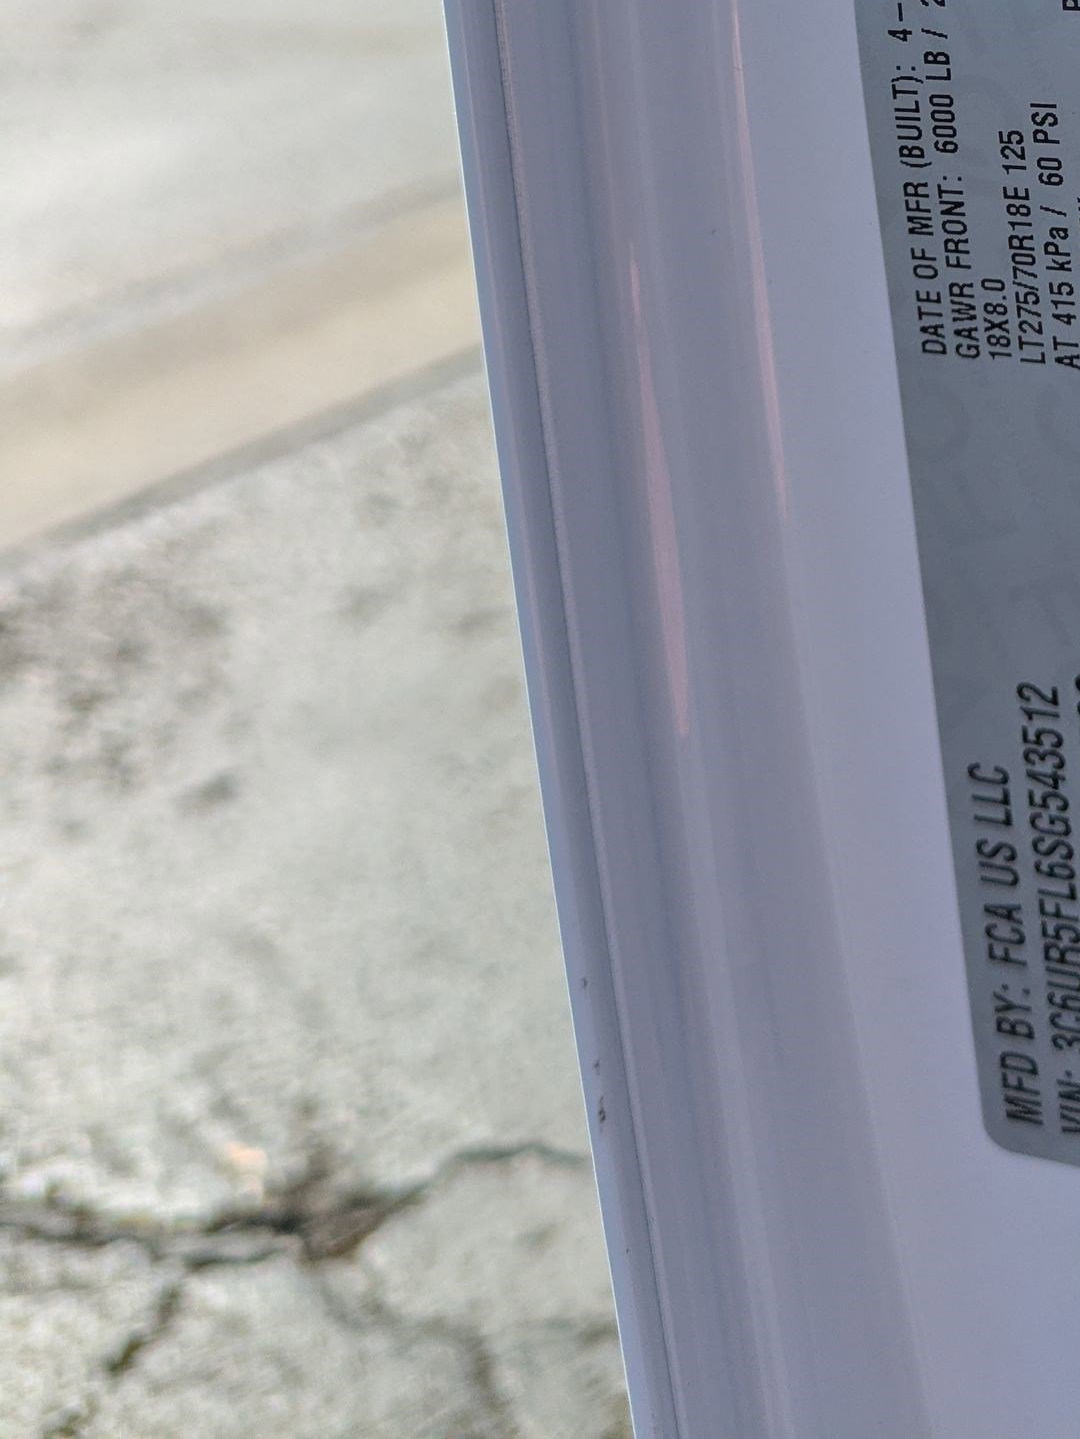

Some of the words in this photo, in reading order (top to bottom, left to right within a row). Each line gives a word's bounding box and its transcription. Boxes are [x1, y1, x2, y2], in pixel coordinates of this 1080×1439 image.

[921, 28, 947, 39] /
[924, 51, 951, 80] LB
[891, 66, 931, 168] (BUILT):
[929, 95, 958, 153] 6000
[1030, 103, 1060, 144] PSI
[999, 131, 1026, 174] 125
[1037, 157, 1063, 186] 60
[903, 182, 933, 236] MFR
[937, 176, 971, 269] FRONT:
[1040, 206, 1066, 217] /
[911, 248, 938, 279] OF
[1003, 187, 1046, 364] LT275/70R18E
[1044, 227, 1072, 271] kPa
[916, 290, 947, 355] DATE
[949, 283, 980, 359] GAWR
[981, 279, 1012, 359] 18X8.0
[1049, 282, 1076, 325] 415
[1053, 336, 1080, 370] AT
[968, 763, 1012, 827] LLC
[976, 840, 1019, 887] US
[984, 905, 1026, 966] FCA
[994, 985, 1034, 1040] BY:
[1000, 1052, 1043, 1125] MFD
